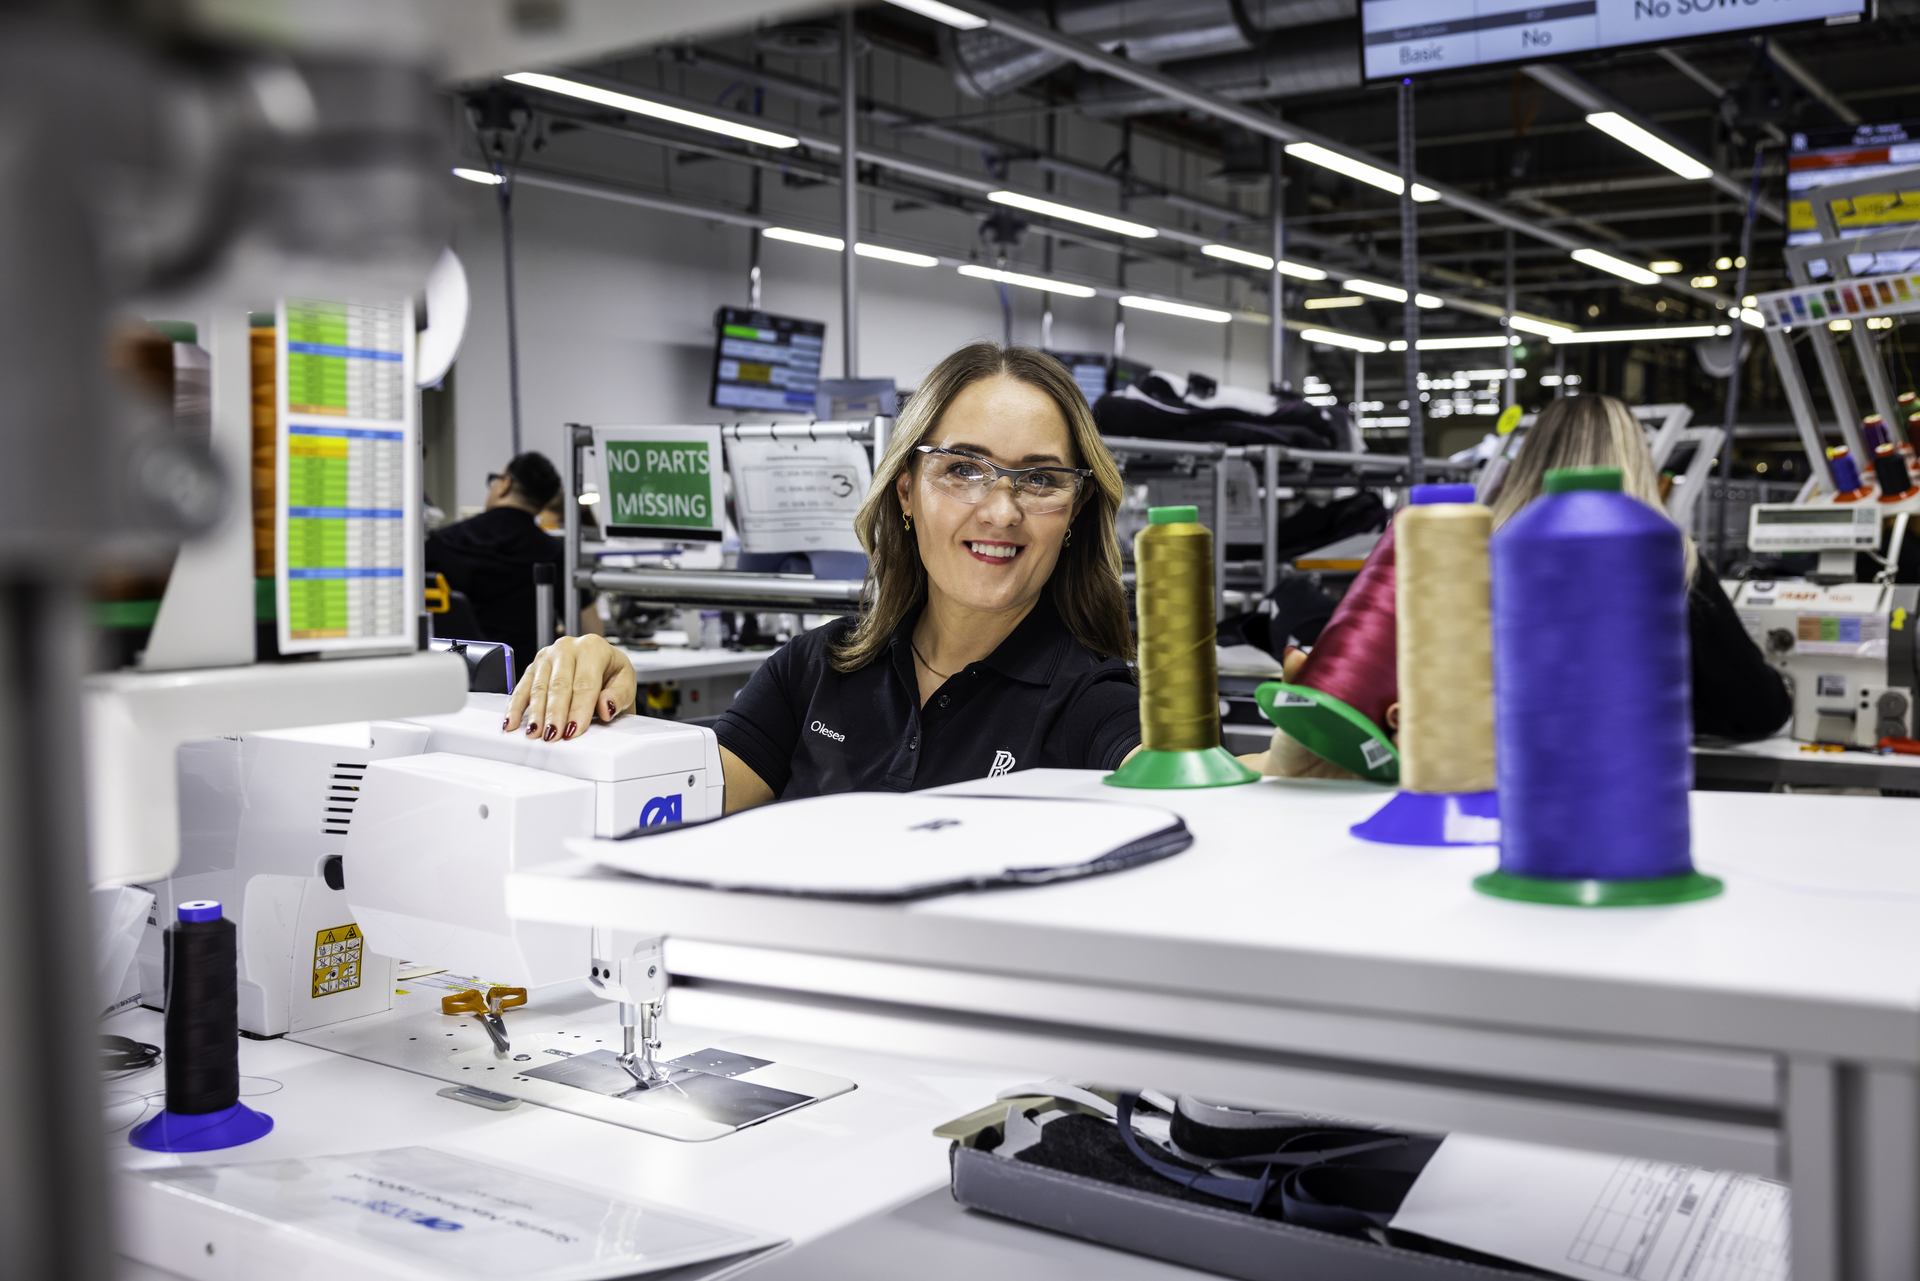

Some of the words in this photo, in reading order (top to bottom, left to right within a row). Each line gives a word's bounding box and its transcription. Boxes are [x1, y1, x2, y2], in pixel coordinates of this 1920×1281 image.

[1635, 0, 1671, 20] No
[1522, 28, 1552, 48] No
[1399, 42, 1445, 65] Basic
[607, 450, 641, 474] NO
[646, 449, 710, 475] PARTS
[831, 474, 854, 498] 3
[616, 493, 707, 518] MISSING
[810, 720, 845, 742] Olesea
